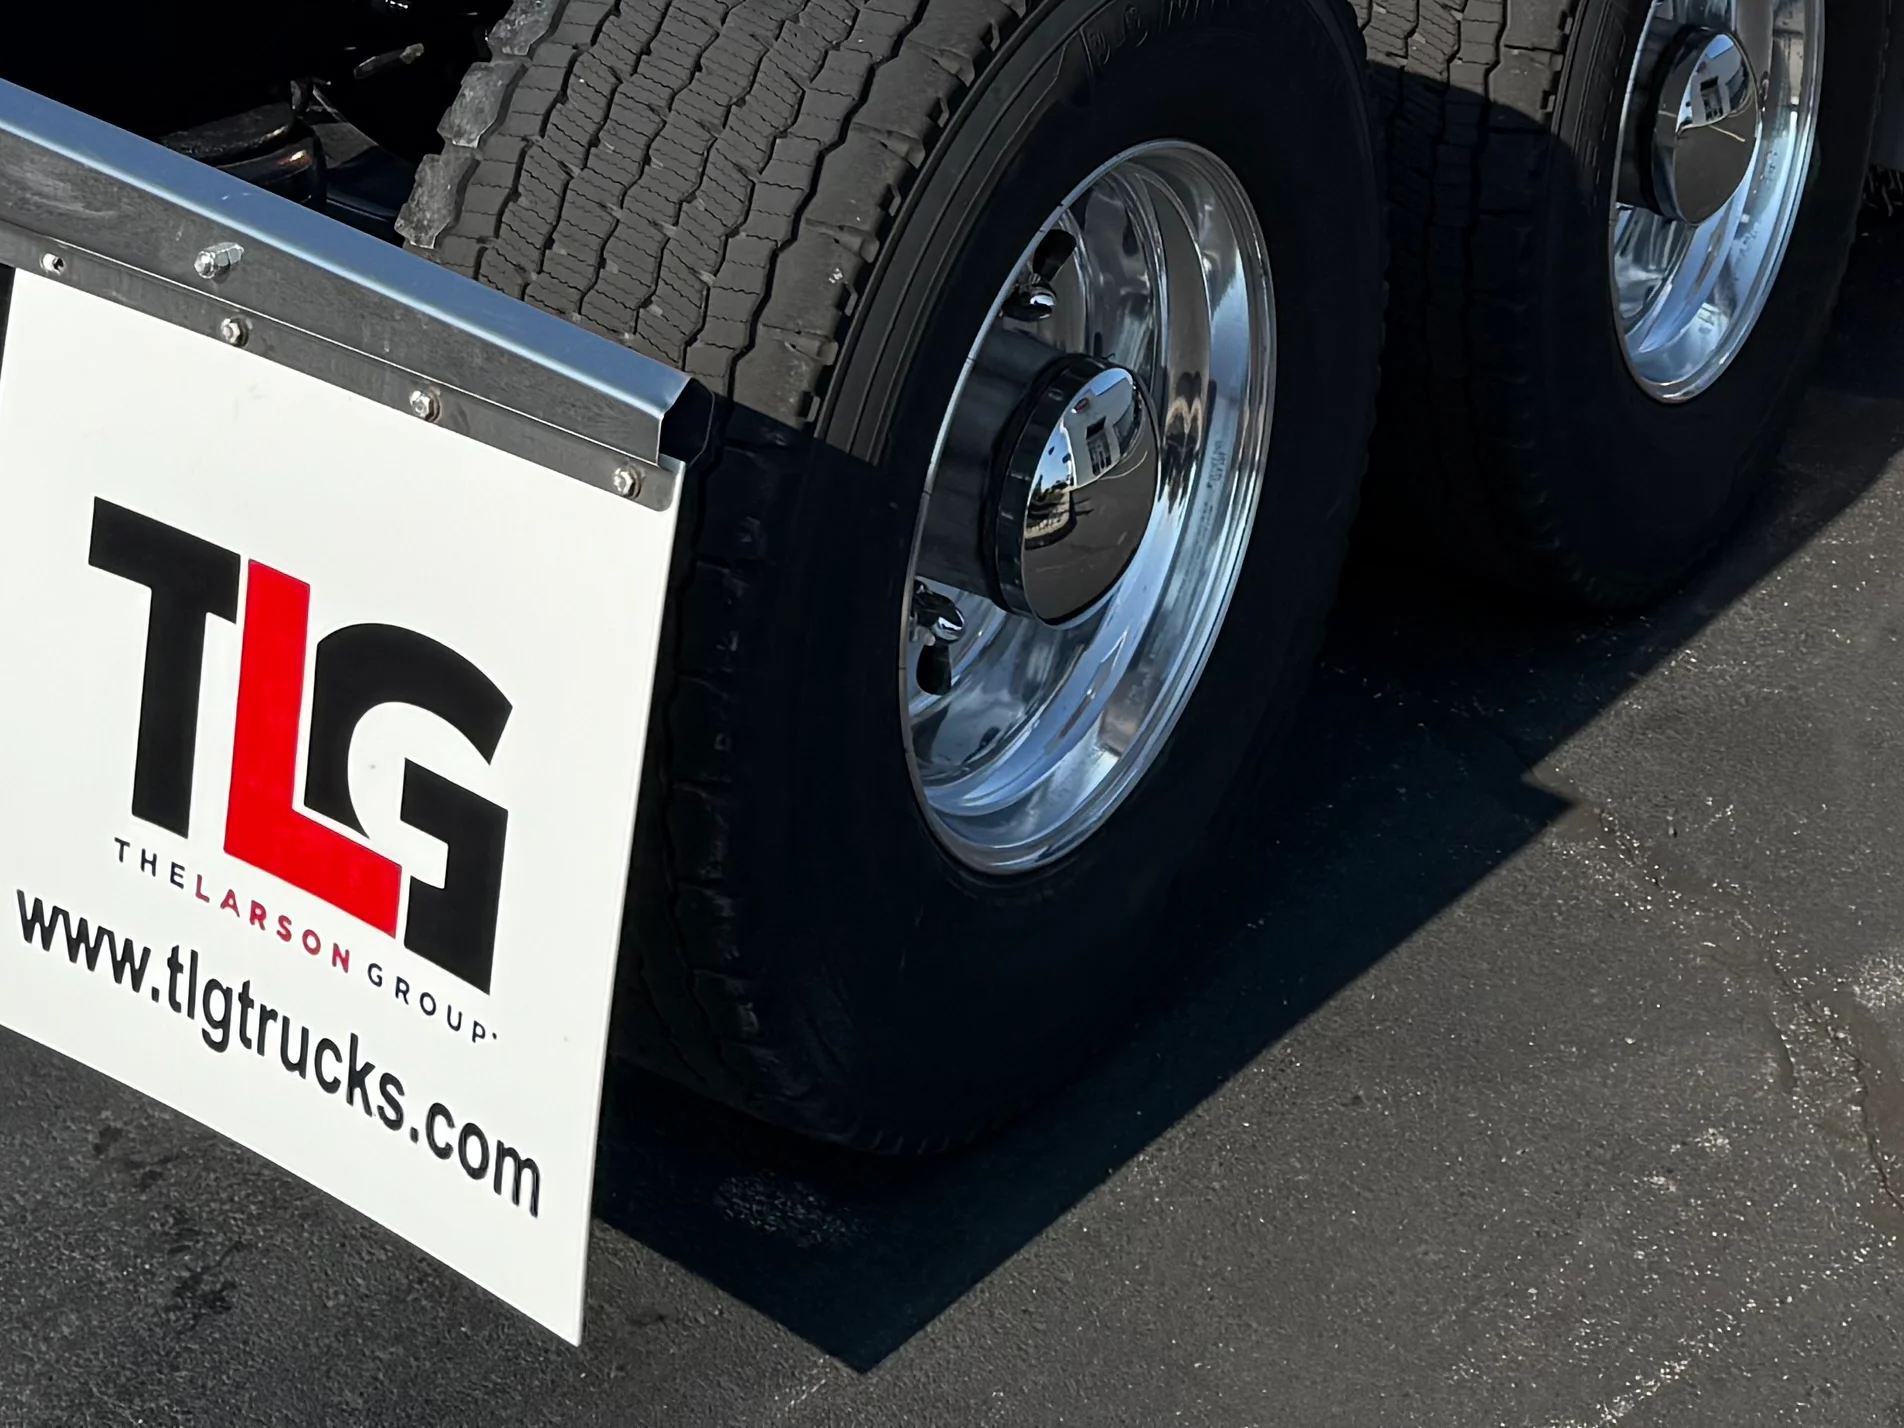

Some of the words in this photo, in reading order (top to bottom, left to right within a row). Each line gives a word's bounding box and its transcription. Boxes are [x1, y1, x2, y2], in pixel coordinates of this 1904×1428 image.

[88, 497, 512, 995] TLG
[17, 890, 540, 1217] www.tlgtrucks.com
[367, 962, 487, 1044] GROUP
